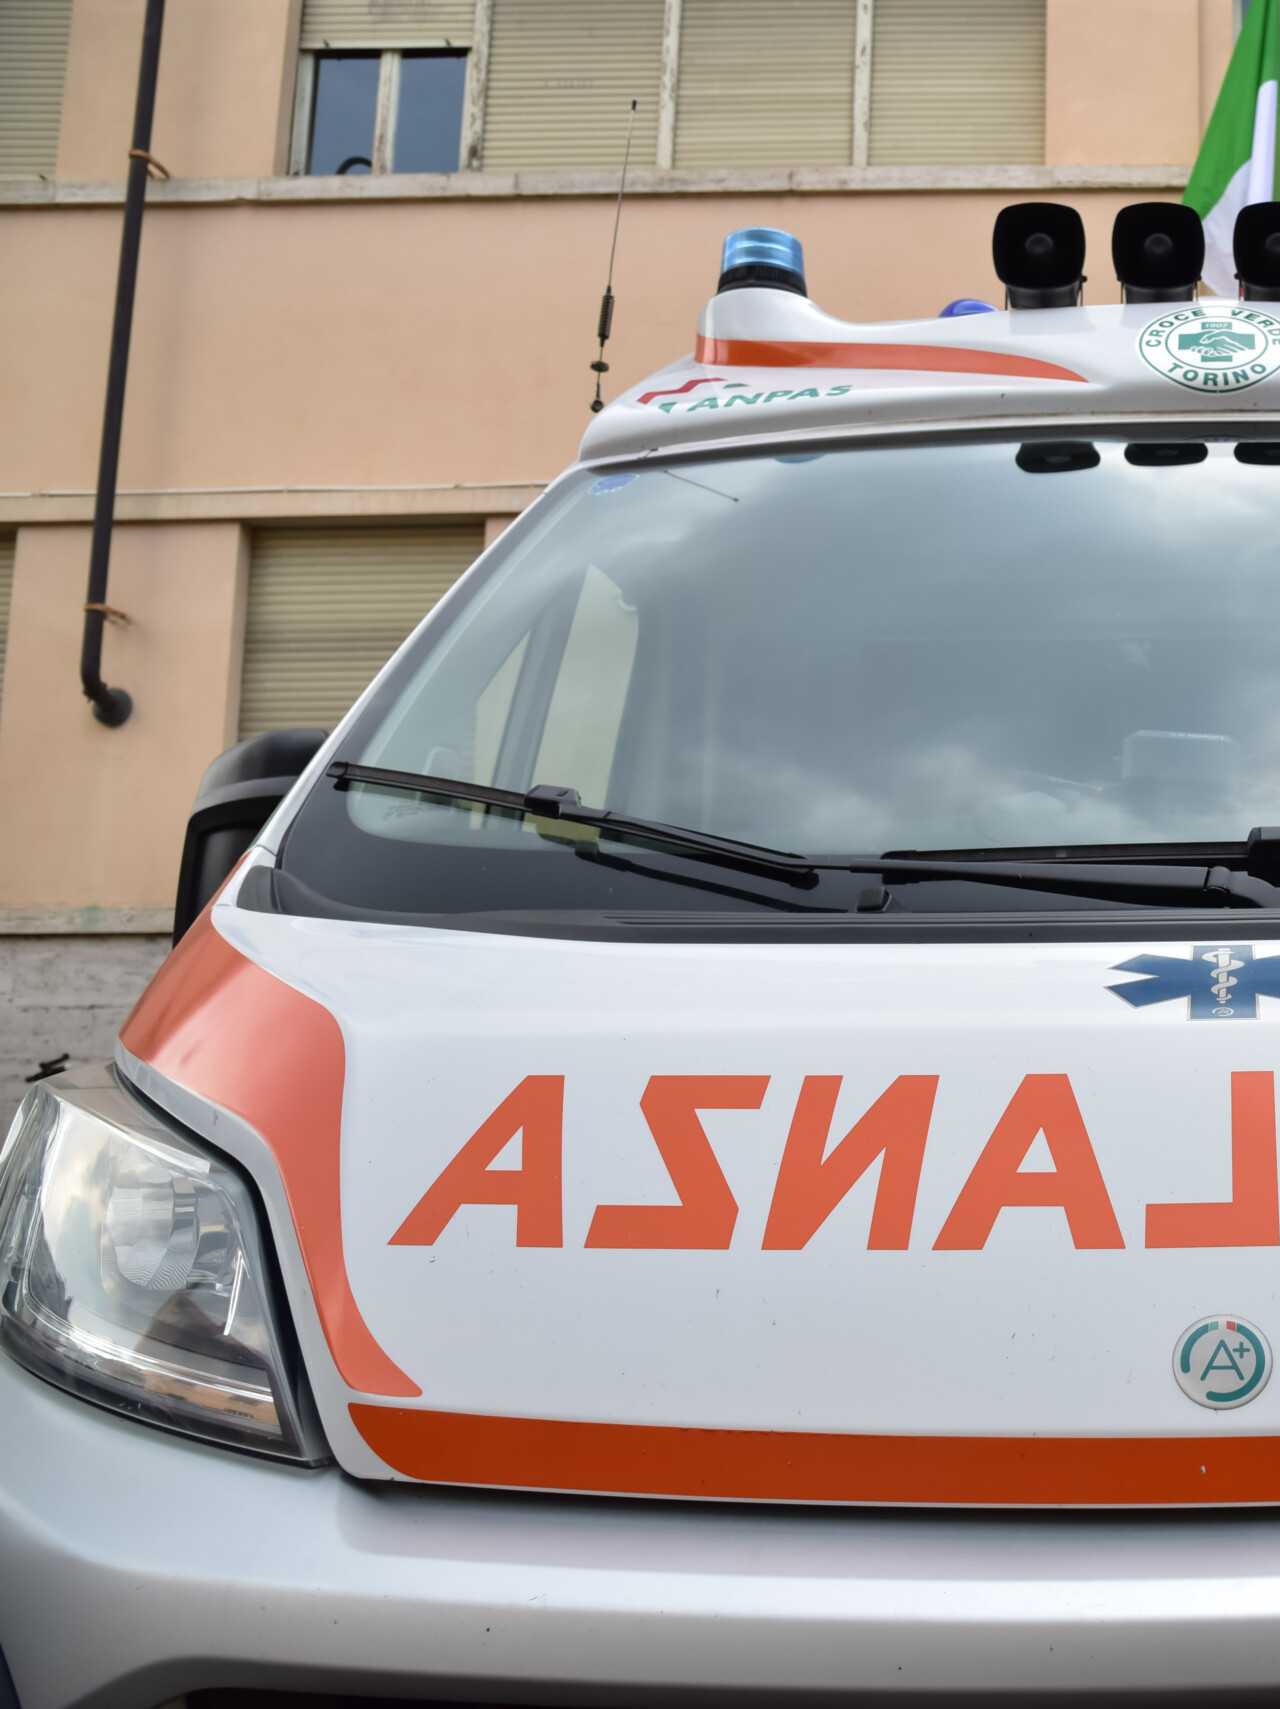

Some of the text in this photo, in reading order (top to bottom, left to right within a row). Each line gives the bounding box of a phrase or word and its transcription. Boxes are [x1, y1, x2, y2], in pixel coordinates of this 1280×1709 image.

[1146, 309, 1206, 347] CROCE
[1167, 363, 1267, 387] TORINO
[686, 385, 854, 412] ANPAS
